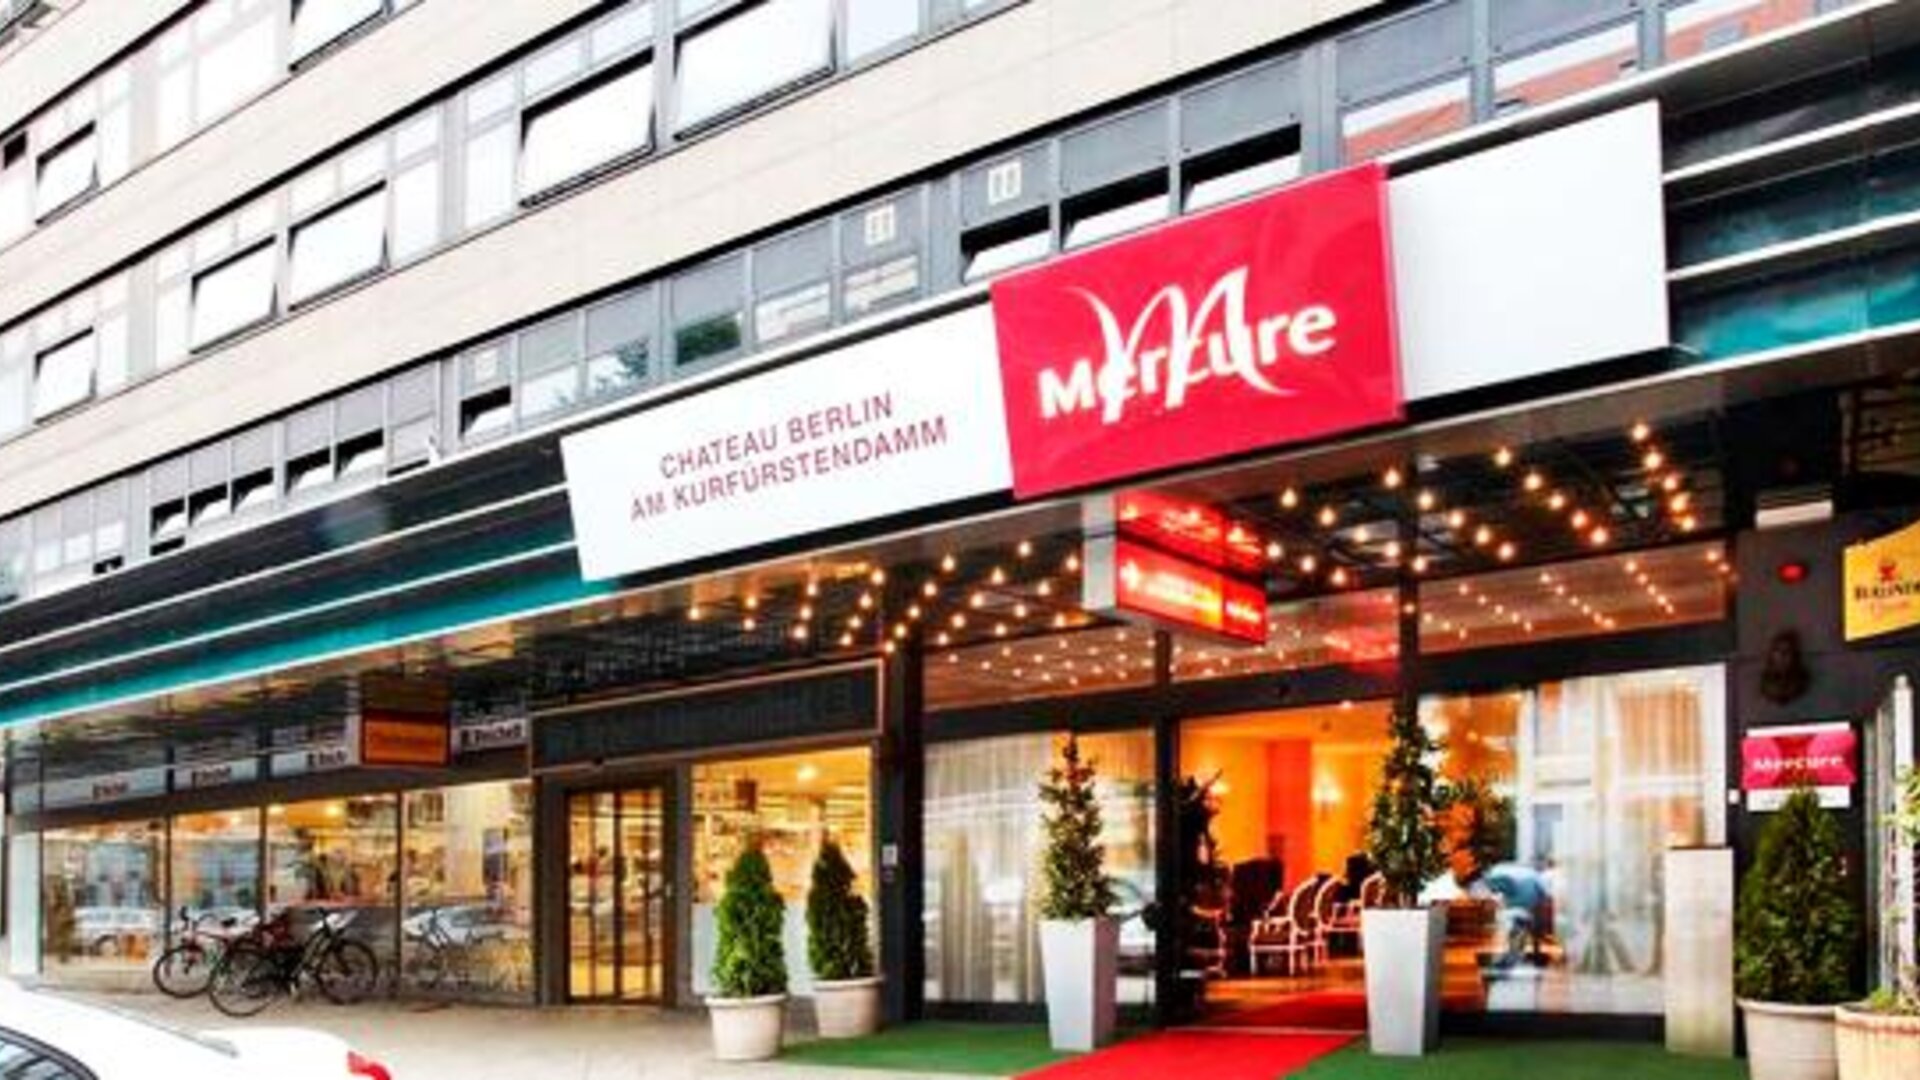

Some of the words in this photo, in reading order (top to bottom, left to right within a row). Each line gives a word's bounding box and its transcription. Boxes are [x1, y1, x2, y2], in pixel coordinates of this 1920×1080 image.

[1037, 265, 1336, 424] Mercure
[659, 424, 778, 480] CHATEAU
[786, 391, 893, 445] BERLIN
[630, 491, 667, 521] AM
[1752, 755, 1844, 774] Mercure
